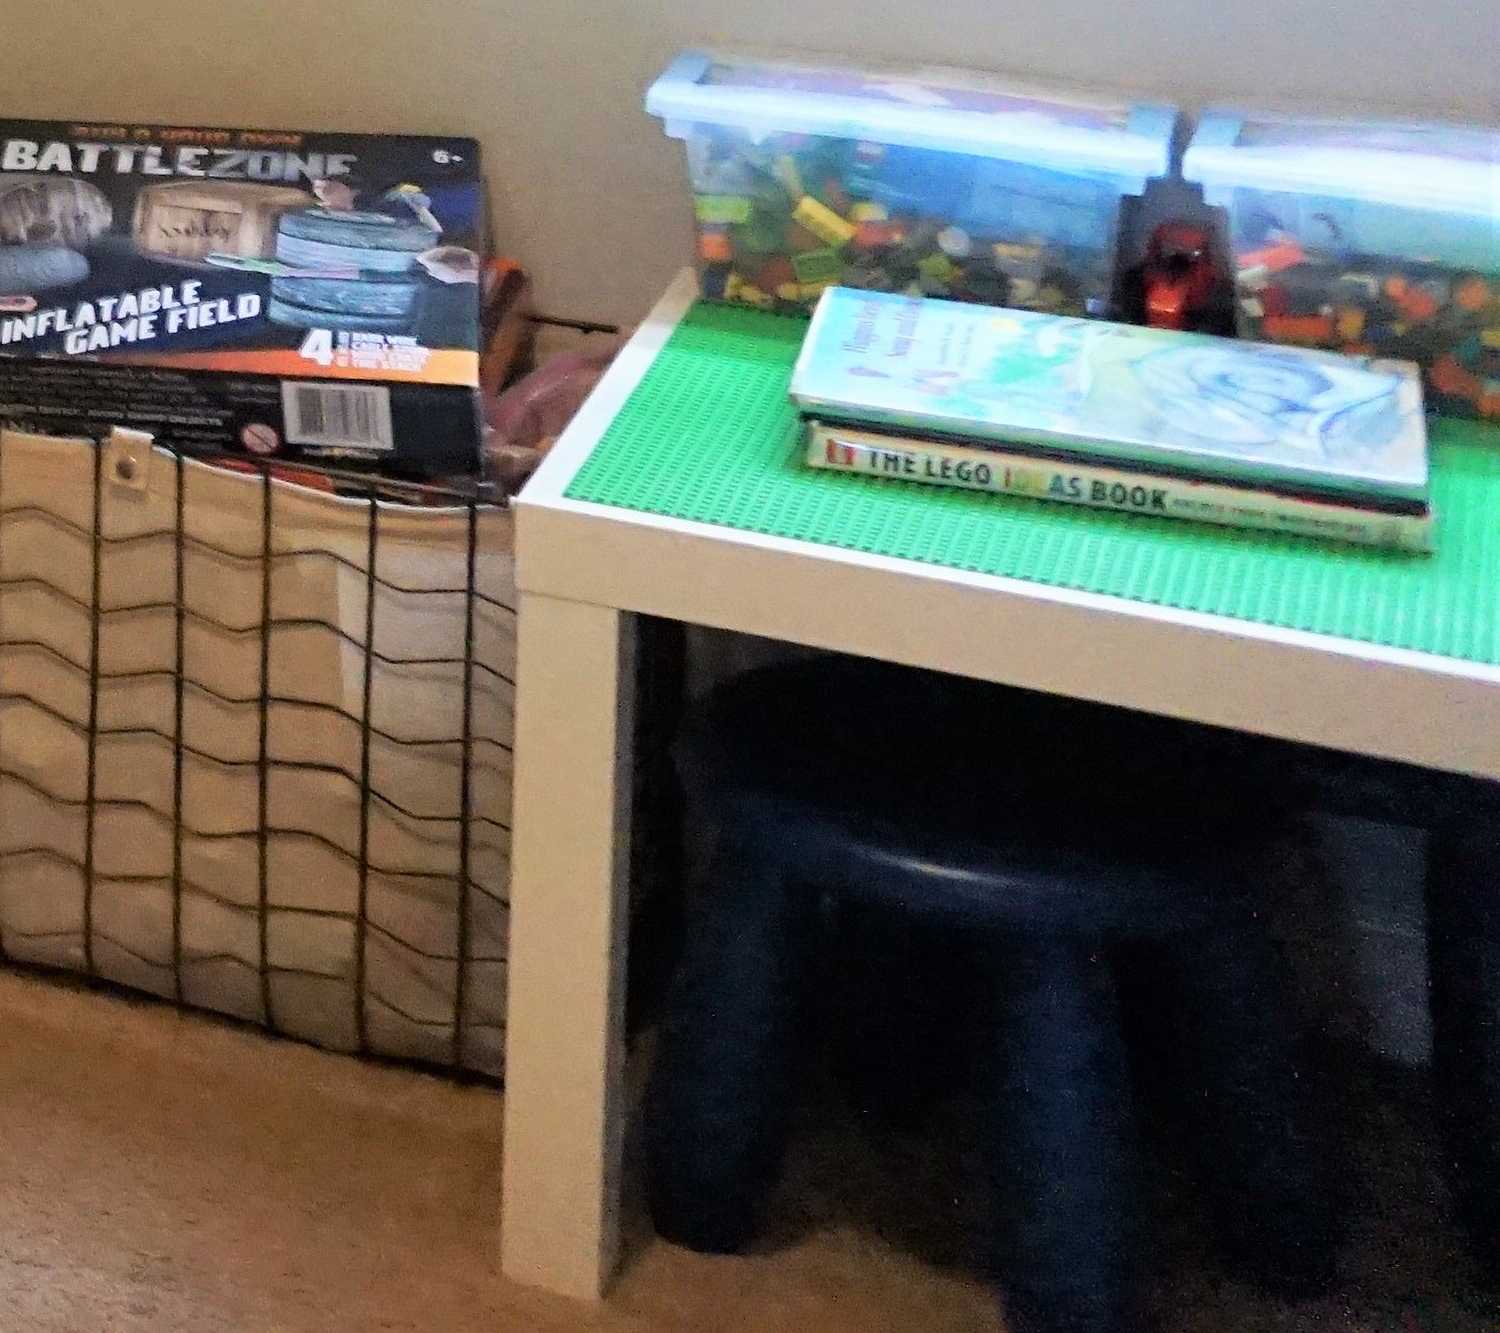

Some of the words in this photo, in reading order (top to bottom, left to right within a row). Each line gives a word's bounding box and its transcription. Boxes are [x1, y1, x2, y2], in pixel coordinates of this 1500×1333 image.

[2, 138, 358, 182] BATTLEZONE
[0, 279, 202, 345] INFLATABLE
[65, 315, 159, 355] GAME
[166, 293, 261, 334] FIELD
[300, 328, 334, 367] 4
[868, 449, 917, 475] THE
[924, 457, 992, 486] LEGO
[1090, 479, 1169, 510] BOOK
